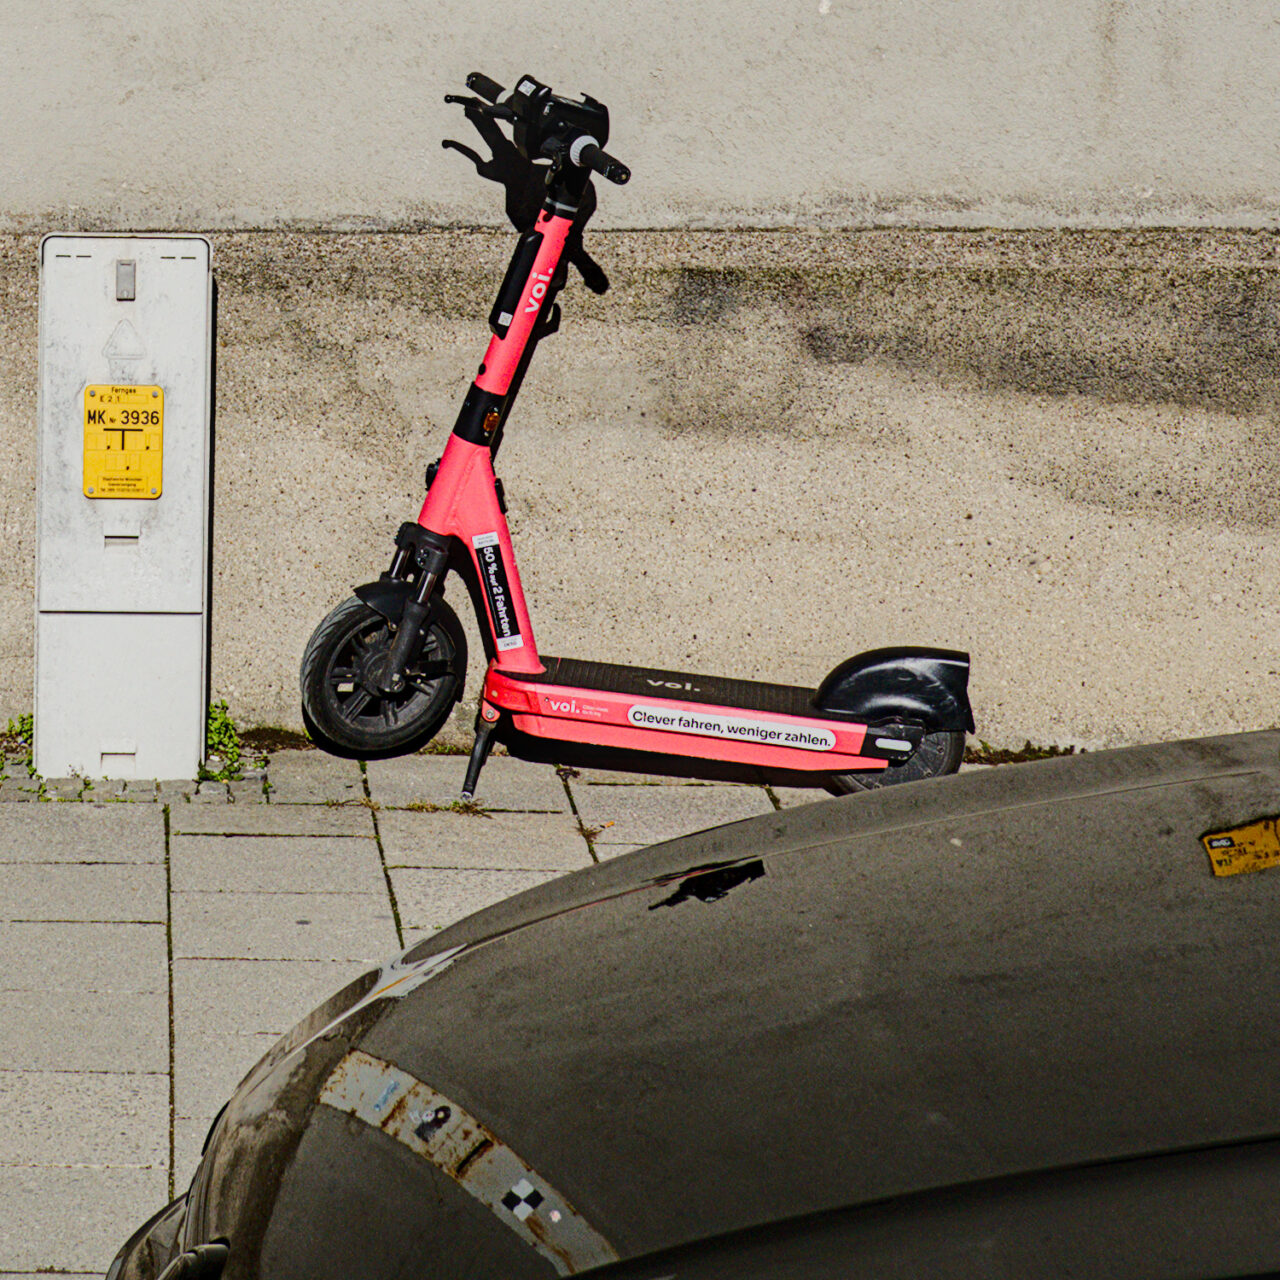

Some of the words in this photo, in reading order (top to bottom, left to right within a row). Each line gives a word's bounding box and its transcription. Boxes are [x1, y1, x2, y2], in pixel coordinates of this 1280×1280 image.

[525, 267, 553, 313] voi.
[87, 409, 106, 424] MK
[120, 410, 160, 425] 3936
[483, 546, 495, 563] 50
[488, 562, 498, 574] %
[492, 586, 503, 595] 2
[494, 594, 511, 637] Fahrten
[646, 679, 701, 692] voi.
[549, 700, 580, 714] voi.
[632, 710, 675, 726] Clever
[678, 716, 724, 734] fahren,
[727, 723, 782, 741] weniger
[784, 731, 831, 747] zahlen.
